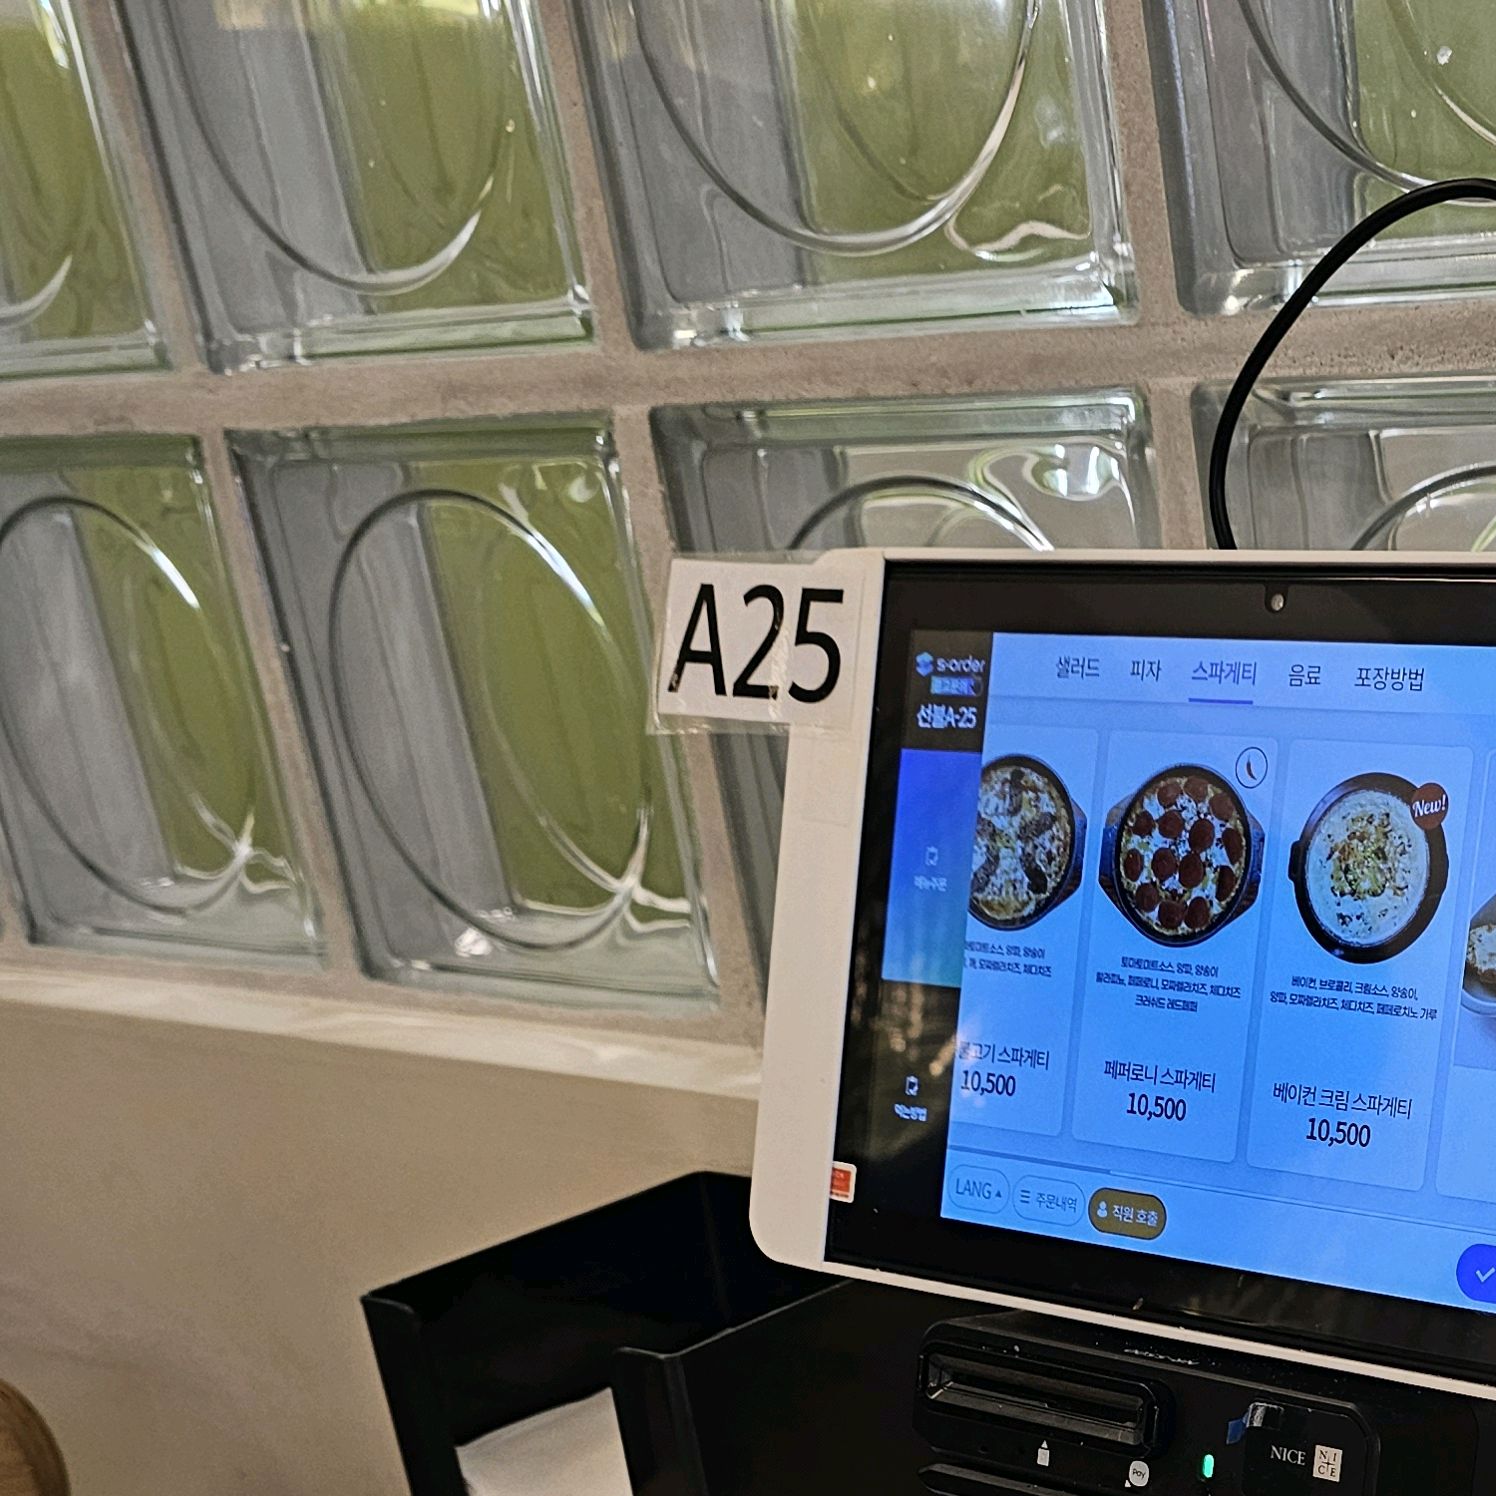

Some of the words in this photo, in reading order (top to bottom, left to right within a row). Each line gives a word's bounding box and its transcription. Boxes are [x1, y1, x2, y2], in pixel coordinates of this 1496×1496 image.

[668, 583, 844, 703] A25
[1056, 655, 1100, 680] 샐러드
[1130, 660, 1162, 683] 피자
[1192, 661, 1258, 686] 스파게티
[1288, 664, 1322, 688] 음료
[1355, 666, 1426, 692] 포장방법
[1412, 793, 1448, 817] New!
[997, 1046, 1050, 1070] 스파게티
[961, 1070, 1016, 1097] 10,500
[1104, 1060, 1158, 1086] 페퍼로니
[1160, 1068, 1217, 1093] 스파게티
[1126, 1092, 1187, 1122] 10,500
[1272, 1082, 1318, 1108] 베이컨
[1319, 1089, 1350, 1112] 크림
[1352, 1093, 1413, 1120] 스파게티
[1305, 1117, 1372, 1148] 10,500
[955, 1178, 993, 1200] LANG
[1112, 1205, 1134, 1223] 직원
[1270, 1444, 1307, 1466] NICE
